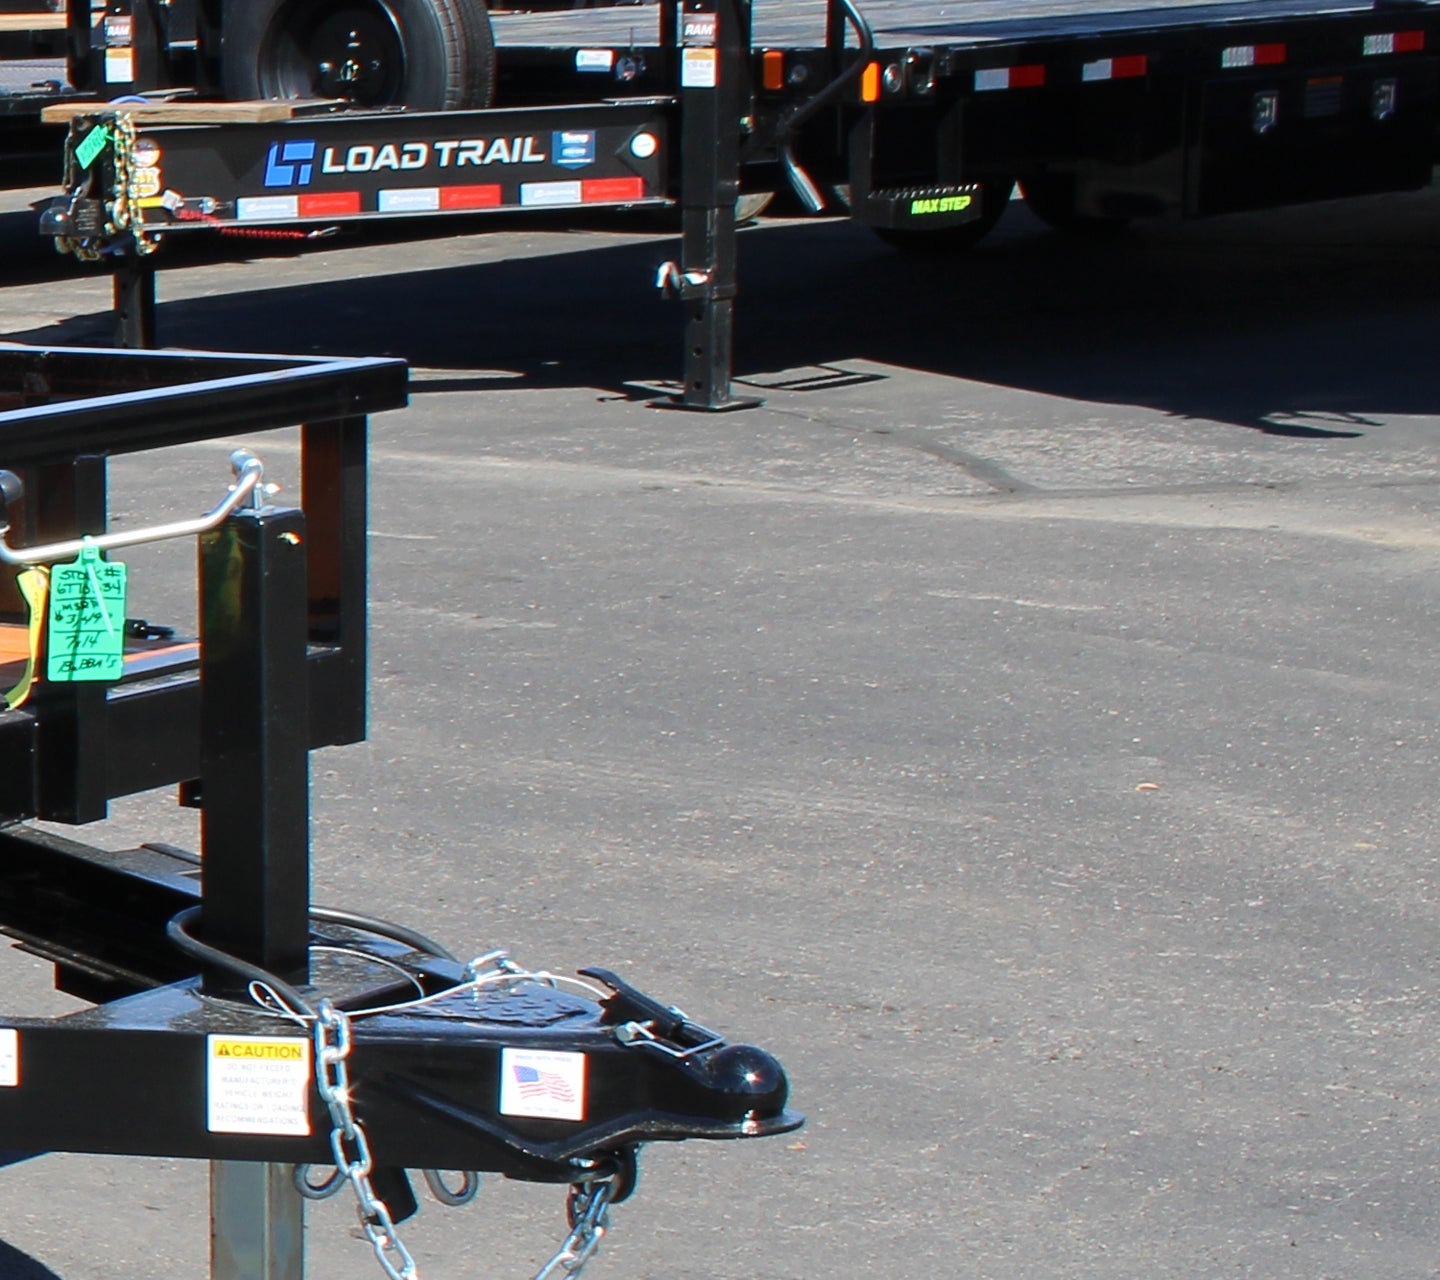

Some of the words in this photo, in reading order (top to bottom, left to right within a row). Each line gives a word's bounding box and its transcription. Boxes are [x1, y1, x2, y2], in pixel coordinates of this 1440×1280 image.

[322, 142, 429, 174] LOAD
[434, 137, 546, 168] TRAIL
[911, 199, 938, 214] MAX
[939, 195, 971, 211] STEP
[232, 1044, 302, 1058] CAUTION
